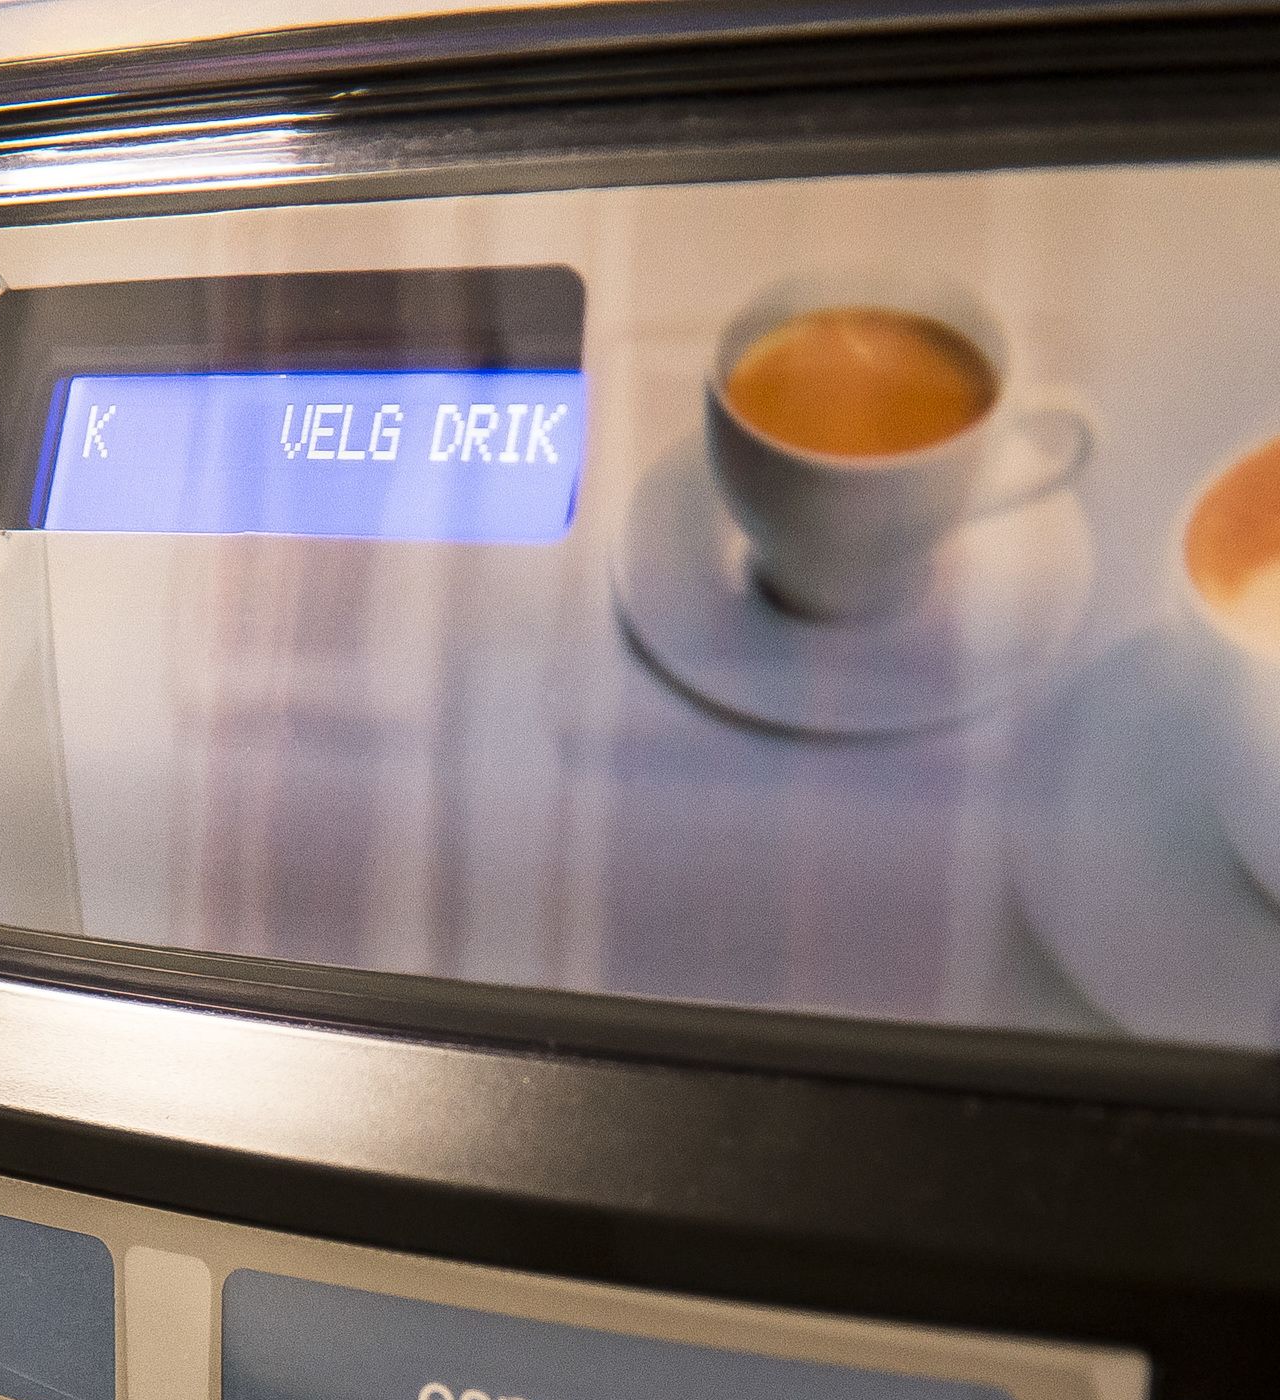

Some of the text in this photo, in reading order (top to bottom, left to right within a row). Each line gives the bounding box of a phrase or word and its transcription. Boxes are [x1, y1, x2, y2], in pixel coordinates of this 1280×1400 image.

[82, 404, 568, 462] K VELG DRIK
